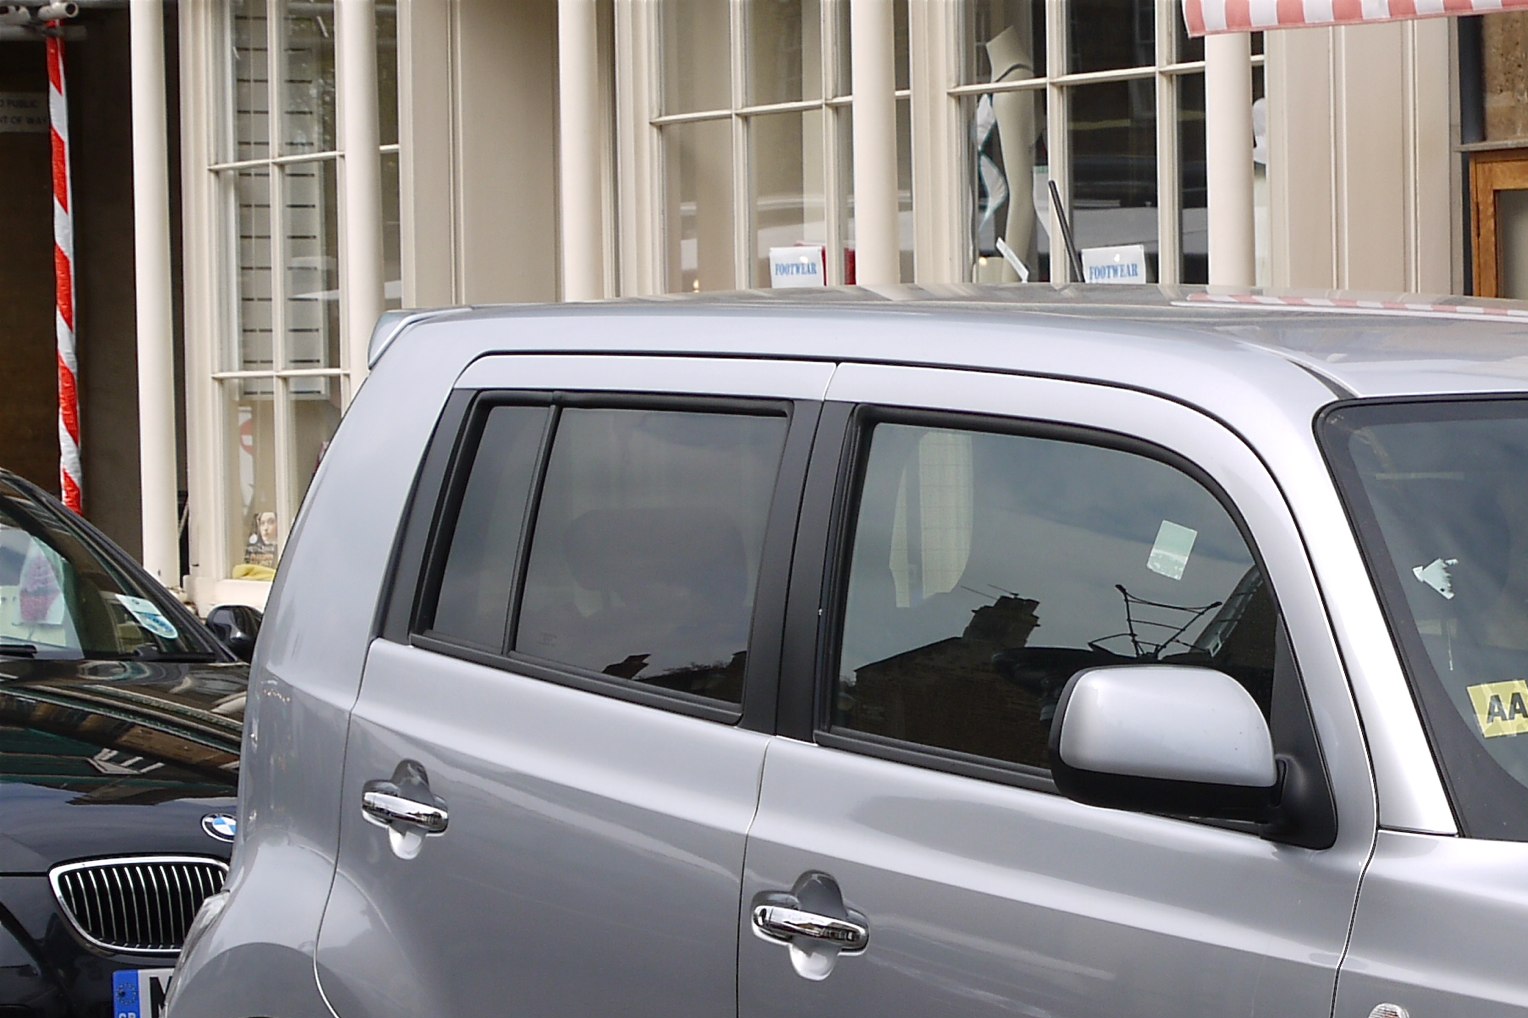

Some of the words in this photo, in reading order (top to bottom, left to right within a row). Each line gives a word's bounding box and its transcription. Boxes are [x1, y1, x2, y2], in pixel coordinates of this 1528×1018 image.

[775, 262, 817, 276] FOOTWEAR
[1089, 263, 1138, 281] FOOTWEAR
[1486, 691, 1528, 724] AA
